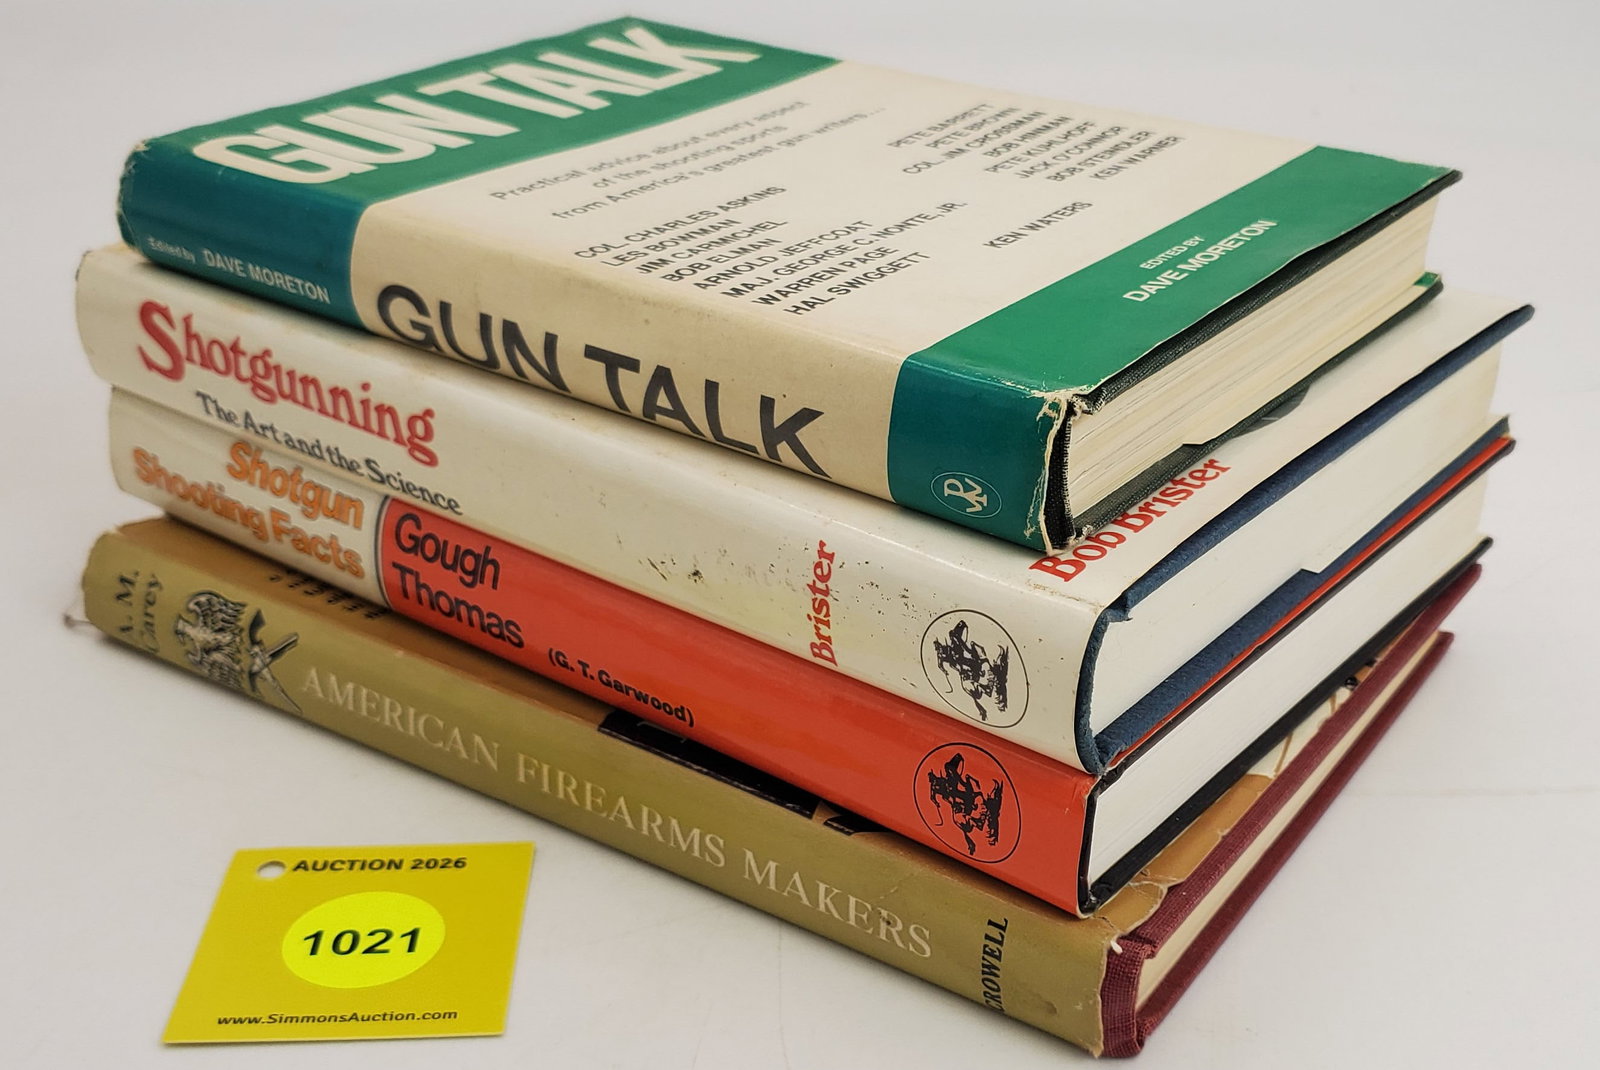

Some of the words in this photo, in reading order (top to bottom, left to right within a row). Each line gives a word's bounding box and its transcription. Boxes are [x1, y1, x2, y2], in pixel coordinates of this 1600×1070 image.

[191, 94, 522, 184] GUN
[417, 27, 762, 119] TALK
[925, 131, 970, 148] PETE
[963, 107, 1022, 131] BROWN
[489, 169, 587, 200] Practical
[587, 153, 651, 173] advice
[651, 135, 706, 155] about
[705, 119, 755, 139] every
[753, 101, 811, 123] aspect
[592, 176, 617, 189] of
[613, 168, 650, 181] the
[650, 143, 736, 171] shooting
[730, 124, 788, 146] sports
[886, 131, 933, 148] PETE
[940, 148, 972, 160] JIM
[982, 141, 1021, 158] BOB
[1014, 116, 1074, 143] HINMAN
[984, 155, 1030, 174] PETE
[1014, 160, 1054, 180] JACK
[1051, 125, 1129, 161] O'CONNOR
[1045, 165, 1085, 182] BOB
[1077, 130, 1157, 168] STEINDLER
[1089, 164, 1129, 181] KEN
[1122, 135, 1185, 166] WARNER
[551, 199, 609, 219] from
[605, 170, 704, 203] America's
[703, 144, 780, 173] greatest
[776, 133, 813, 148] gun
[601, 250, 649, 267] LES
[643, 219, 742, 252] BOWMAN
[624, 210, 719, 242] CHARLES
[716, 186, 787, 212] ASKINS
[982, 231, 1028, 249] KEN
[1018, 201, 1093, 233] WATERS
[147, 237, 181, 258] Edited
[180, 246, 196, 264] by
[202, 248, 247, 278] DAVE
[248, 262, 331, 304] MORETON
[635, 258, 676, 275] JIM
[671, 220, 788, 259] CARMICHEL
[660, 262, 712, 282] BOB
[706, 237, 783, 264] ELMAN
[693, 254, 779, 290] ARNOLD
[778, 219, 874, 258] JEFFCOAT
[720, 276, 780, 299] MAJ.
[772, 244, 858, 278] GEORGE
[852, 237, 880, 247] C.
[754, 266, 847, 306] WARREN
[838, 247, 899, 269] PAGE
[1122, 269, 1190, 302] DAVE
[1176, 219, 1278, 272] MORETON
[1138, 245, 1189, 270] EDITED
[1182, 235, 1206, 247] BY
[783, 296, 836, 316] HAL
[827, 251, 931, 296] SWIGGETT
[137, 300, 440, 468] Shotgunning
[377, 284, 572, 394] GUN
[584, 343, 833, 479] TALK
[196, 390, 241, 428] The
[243, 413, 280, 447] Art
[283, 437, 325, 471] and
[325, 446, 365, 479] the
[364, 459, 464, 516] Science
[132, 447, 270, 543] Shooting
[268, 509, 366, 580] Facts
[226, 441, 365, 531] Shotgun
[1028, 530, 1127, 583] Bob
[1112, 458, 1232, 533] Brister
[394, 513, 501, 590] Gough
[114, 569, 142, 605] M.
[391, 562, 525, 650] Thomas
[806, 540, 840, 668] Brister
[548, 650, 580, 675] (G.
[580, 659, 598, 682] T.
[597, 670, 695, 728] Garwood)
[302, 667, 500, 772] AMERICAN
[515, 752, 727, 868] FIREARMS
[743, 848, 933, 959] MAKERS
[292, 858, 404, 873] AUCTION
[410, 856, 467, 870] 2026
[302, 927, 422, 957] 1021
[980, 917, 1009, 1013] CROWELL
[216, 1008, 459, 1025] www.SimmonsAuction.com
